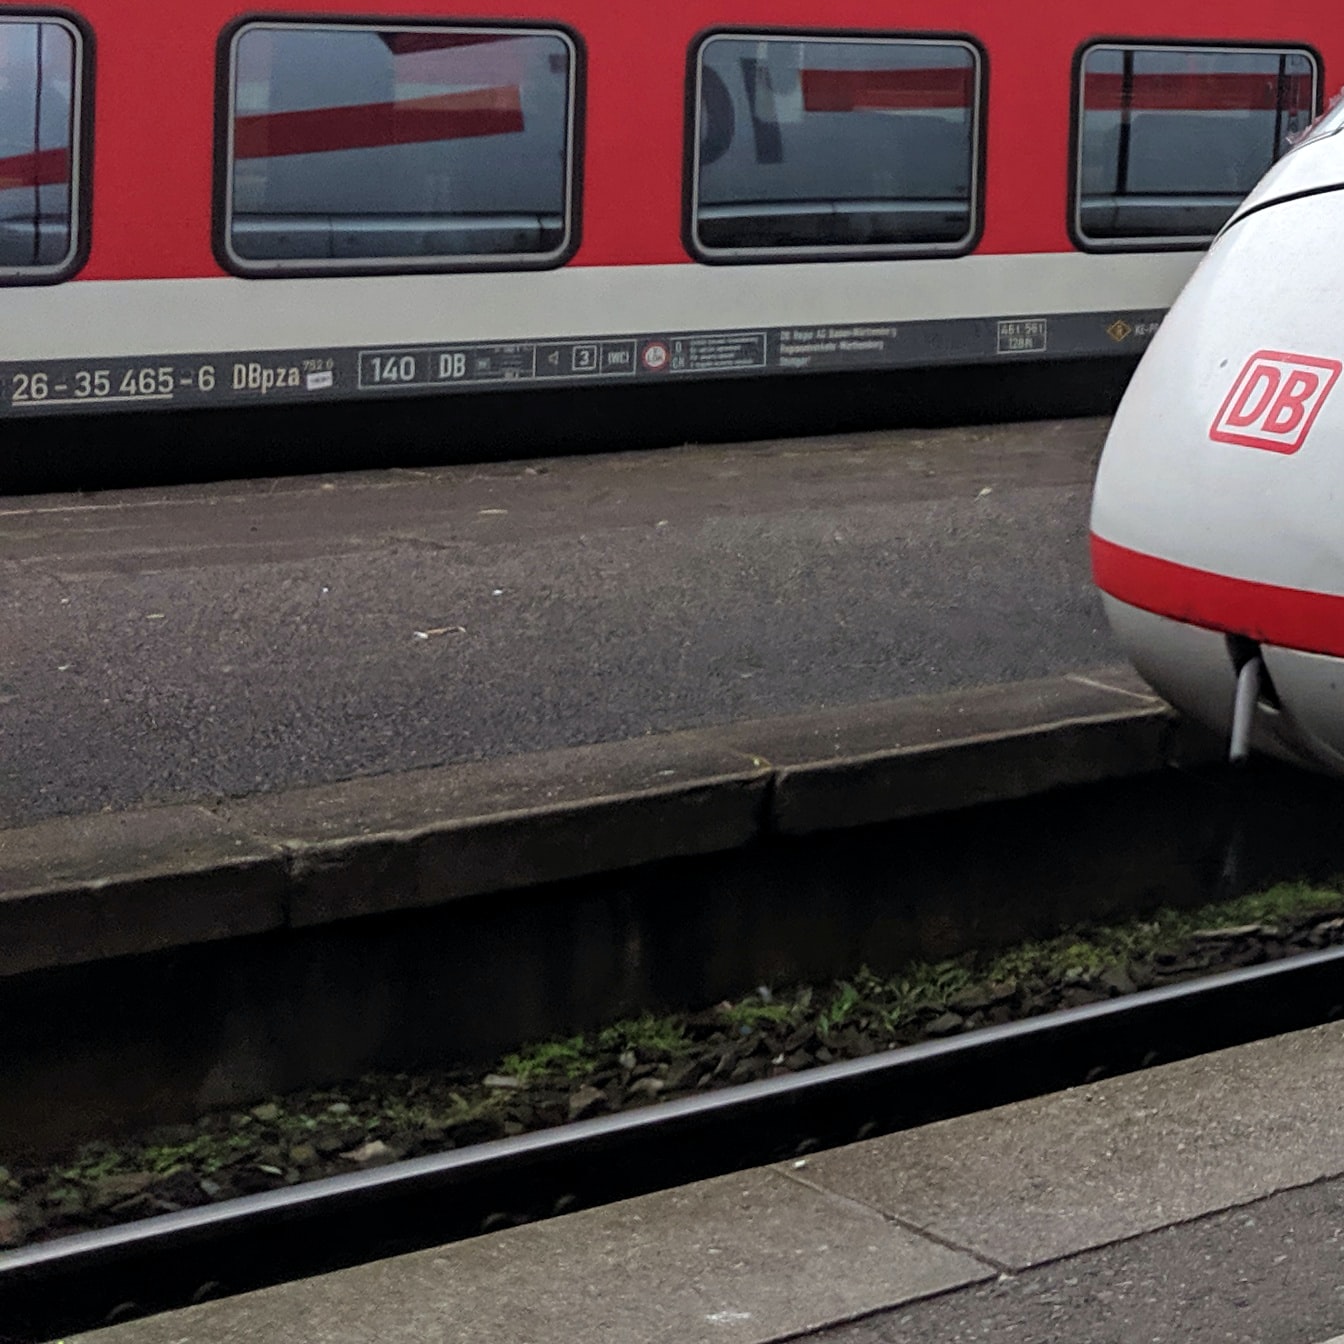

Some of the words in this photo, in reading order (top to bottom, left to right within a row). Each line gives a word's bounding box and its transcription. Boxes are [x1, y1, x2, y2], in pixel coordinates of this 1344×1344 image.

[371, 355, 415, 382] 140
[439, 353, 466, 378] DB
[579, 349, 589, 366] 3
[232, 362, 300, 395] DBpza
[1223, 362, 1321, 436] DB
